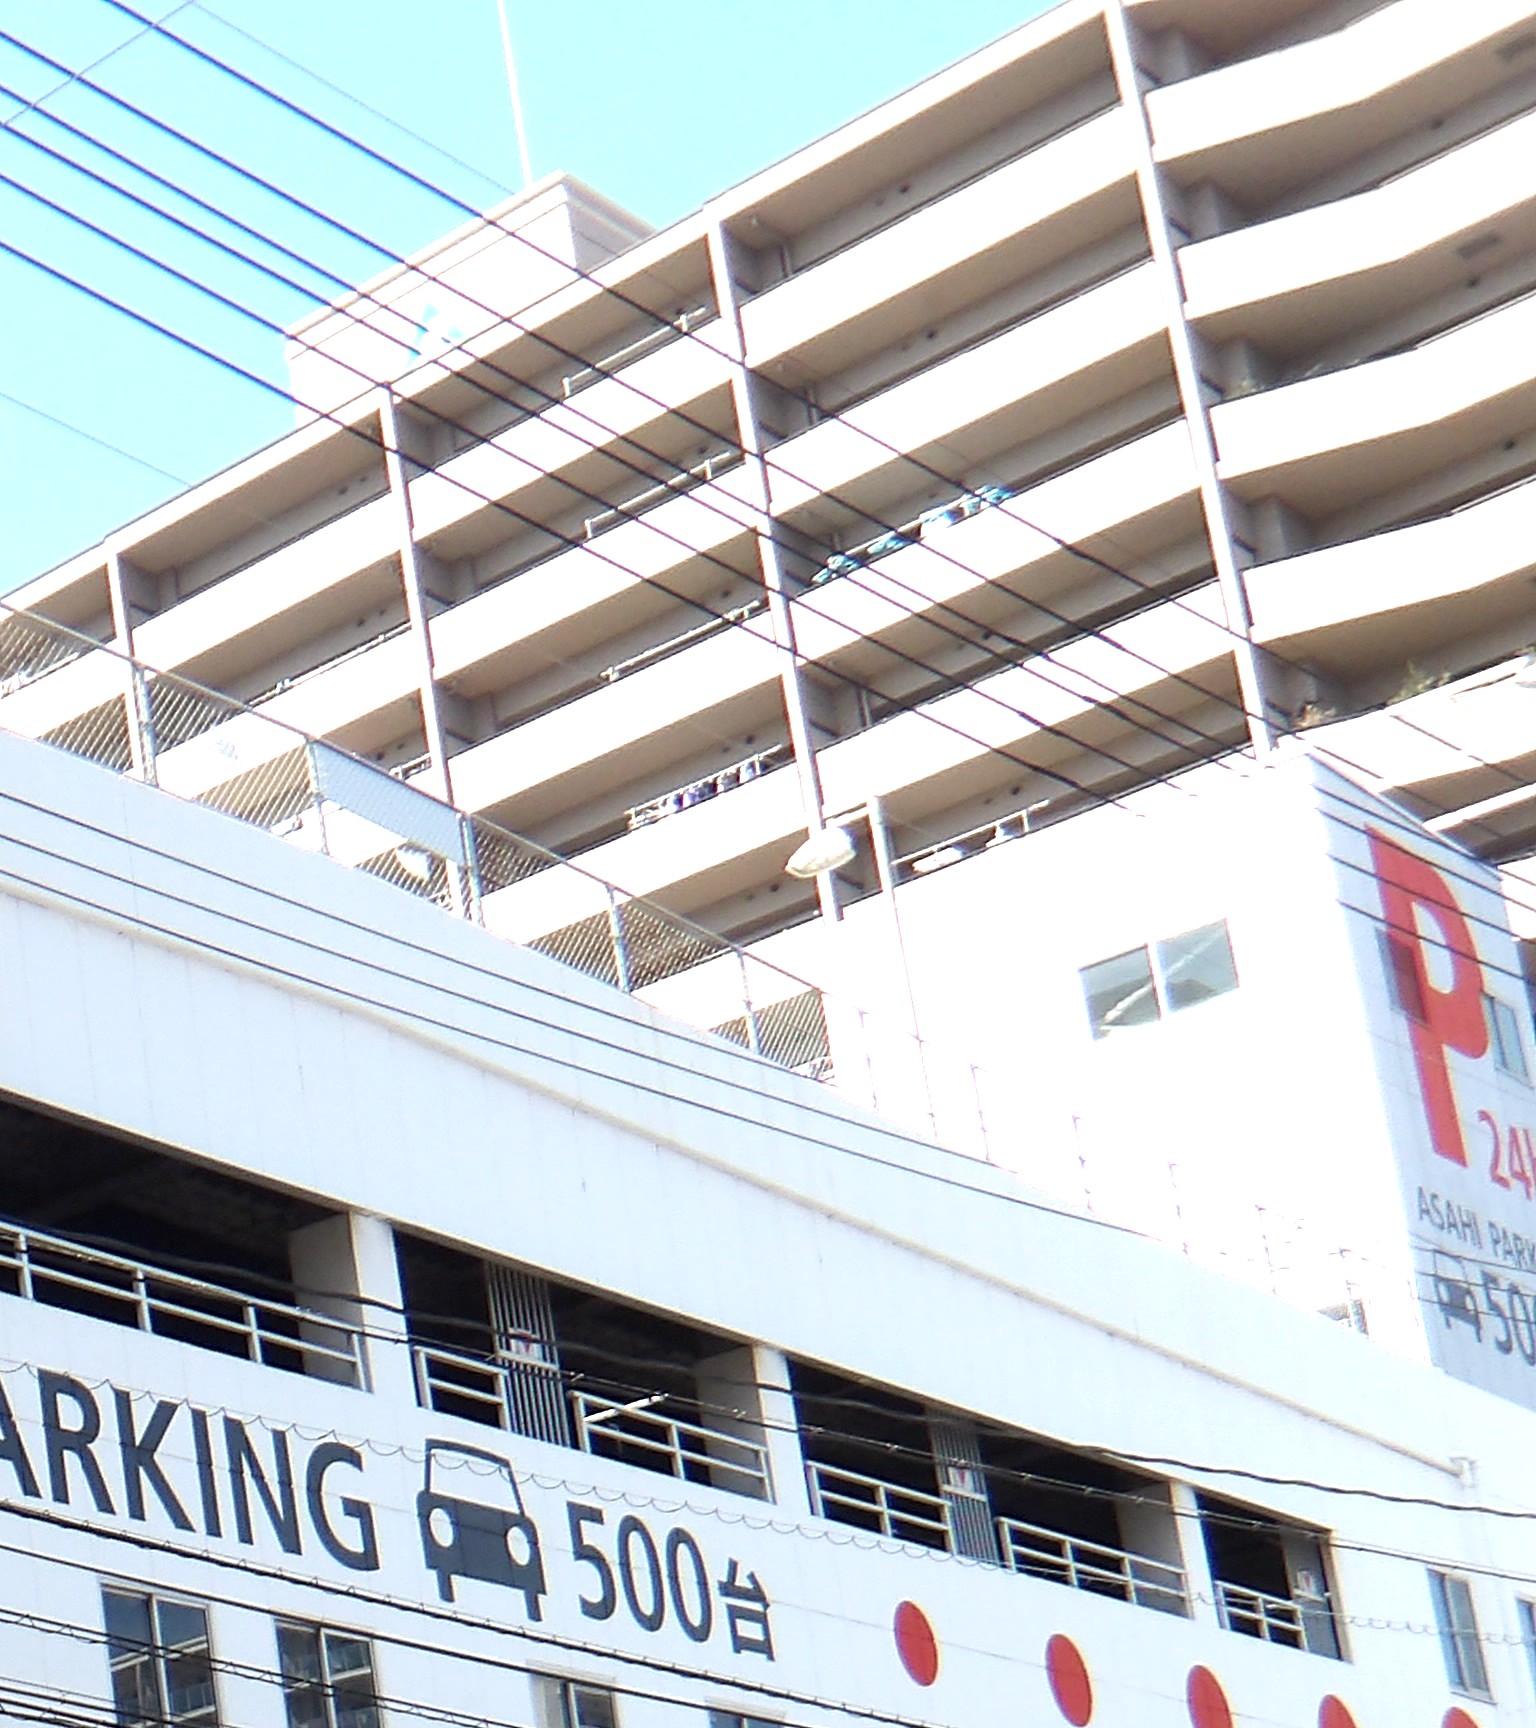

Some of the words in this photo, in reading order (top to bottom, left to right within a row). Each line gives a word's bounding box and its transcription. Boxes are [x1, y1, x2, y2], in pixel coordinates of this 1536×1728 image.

[1364, 823, 1490, 1168] P
[1417, 1185, 1483, 1250] ASAHI
[1479, 1268, 1536, 1368] 50
[568, 1501, 776, 1663] 500台
